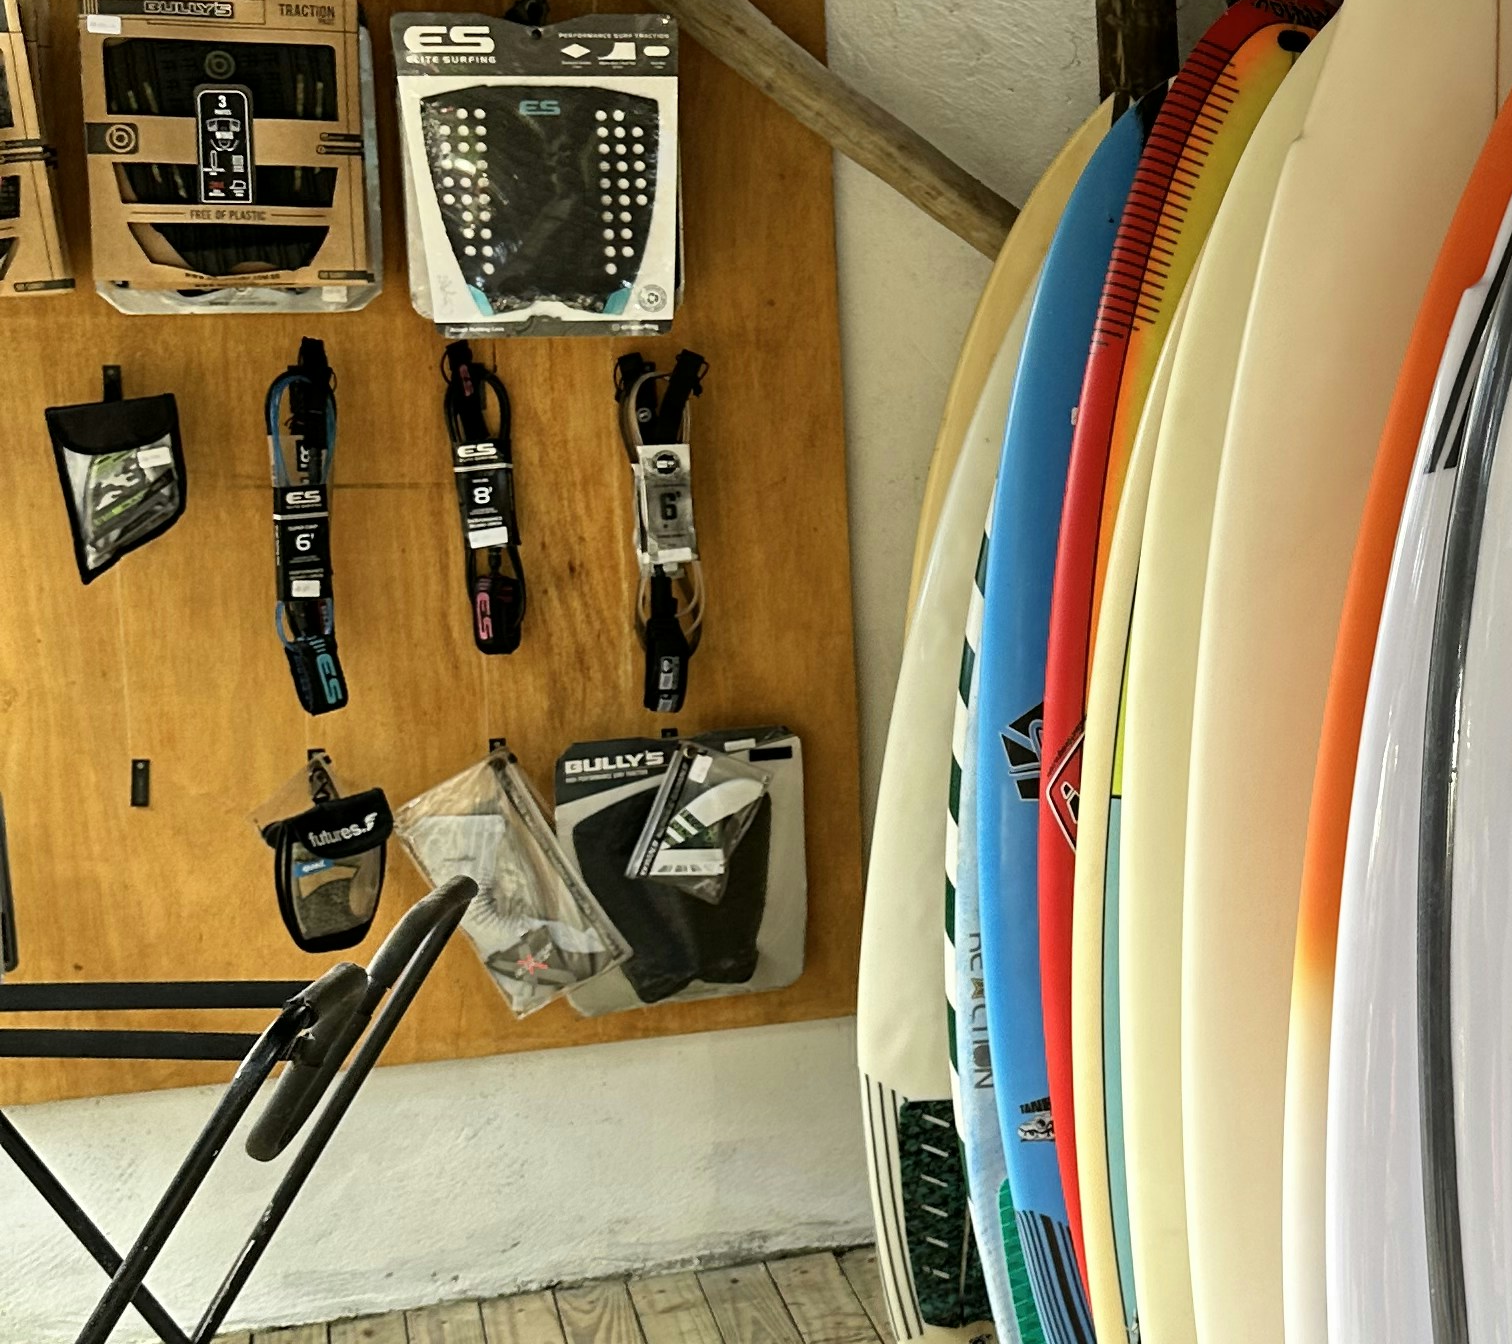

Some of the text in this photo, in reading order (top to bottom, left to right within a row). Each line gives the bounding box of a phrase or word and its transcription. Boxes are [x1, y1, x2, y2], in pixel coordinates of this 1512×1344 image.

[144, 0, 233, 18] BULLY'S
[278, 3, 336, 19] TRACTION
[403, 25, 495, 53] ES
[405, 55, 497, 64] ELITE SURFING
[218, 95, 228, 108] 3
[519, 100, 561, 116] ES
[189, 208, 267, 222] FREE OF PLASTIC
[457, 443, 498, 458] ES
[285, 490, 322, 506] ES
[295, 533, 315, 552] 6'
[476, 592, 493, 641] ES
[316, 653, 343, 705] ES
[565, 750, 664, 774] BULLY'S
